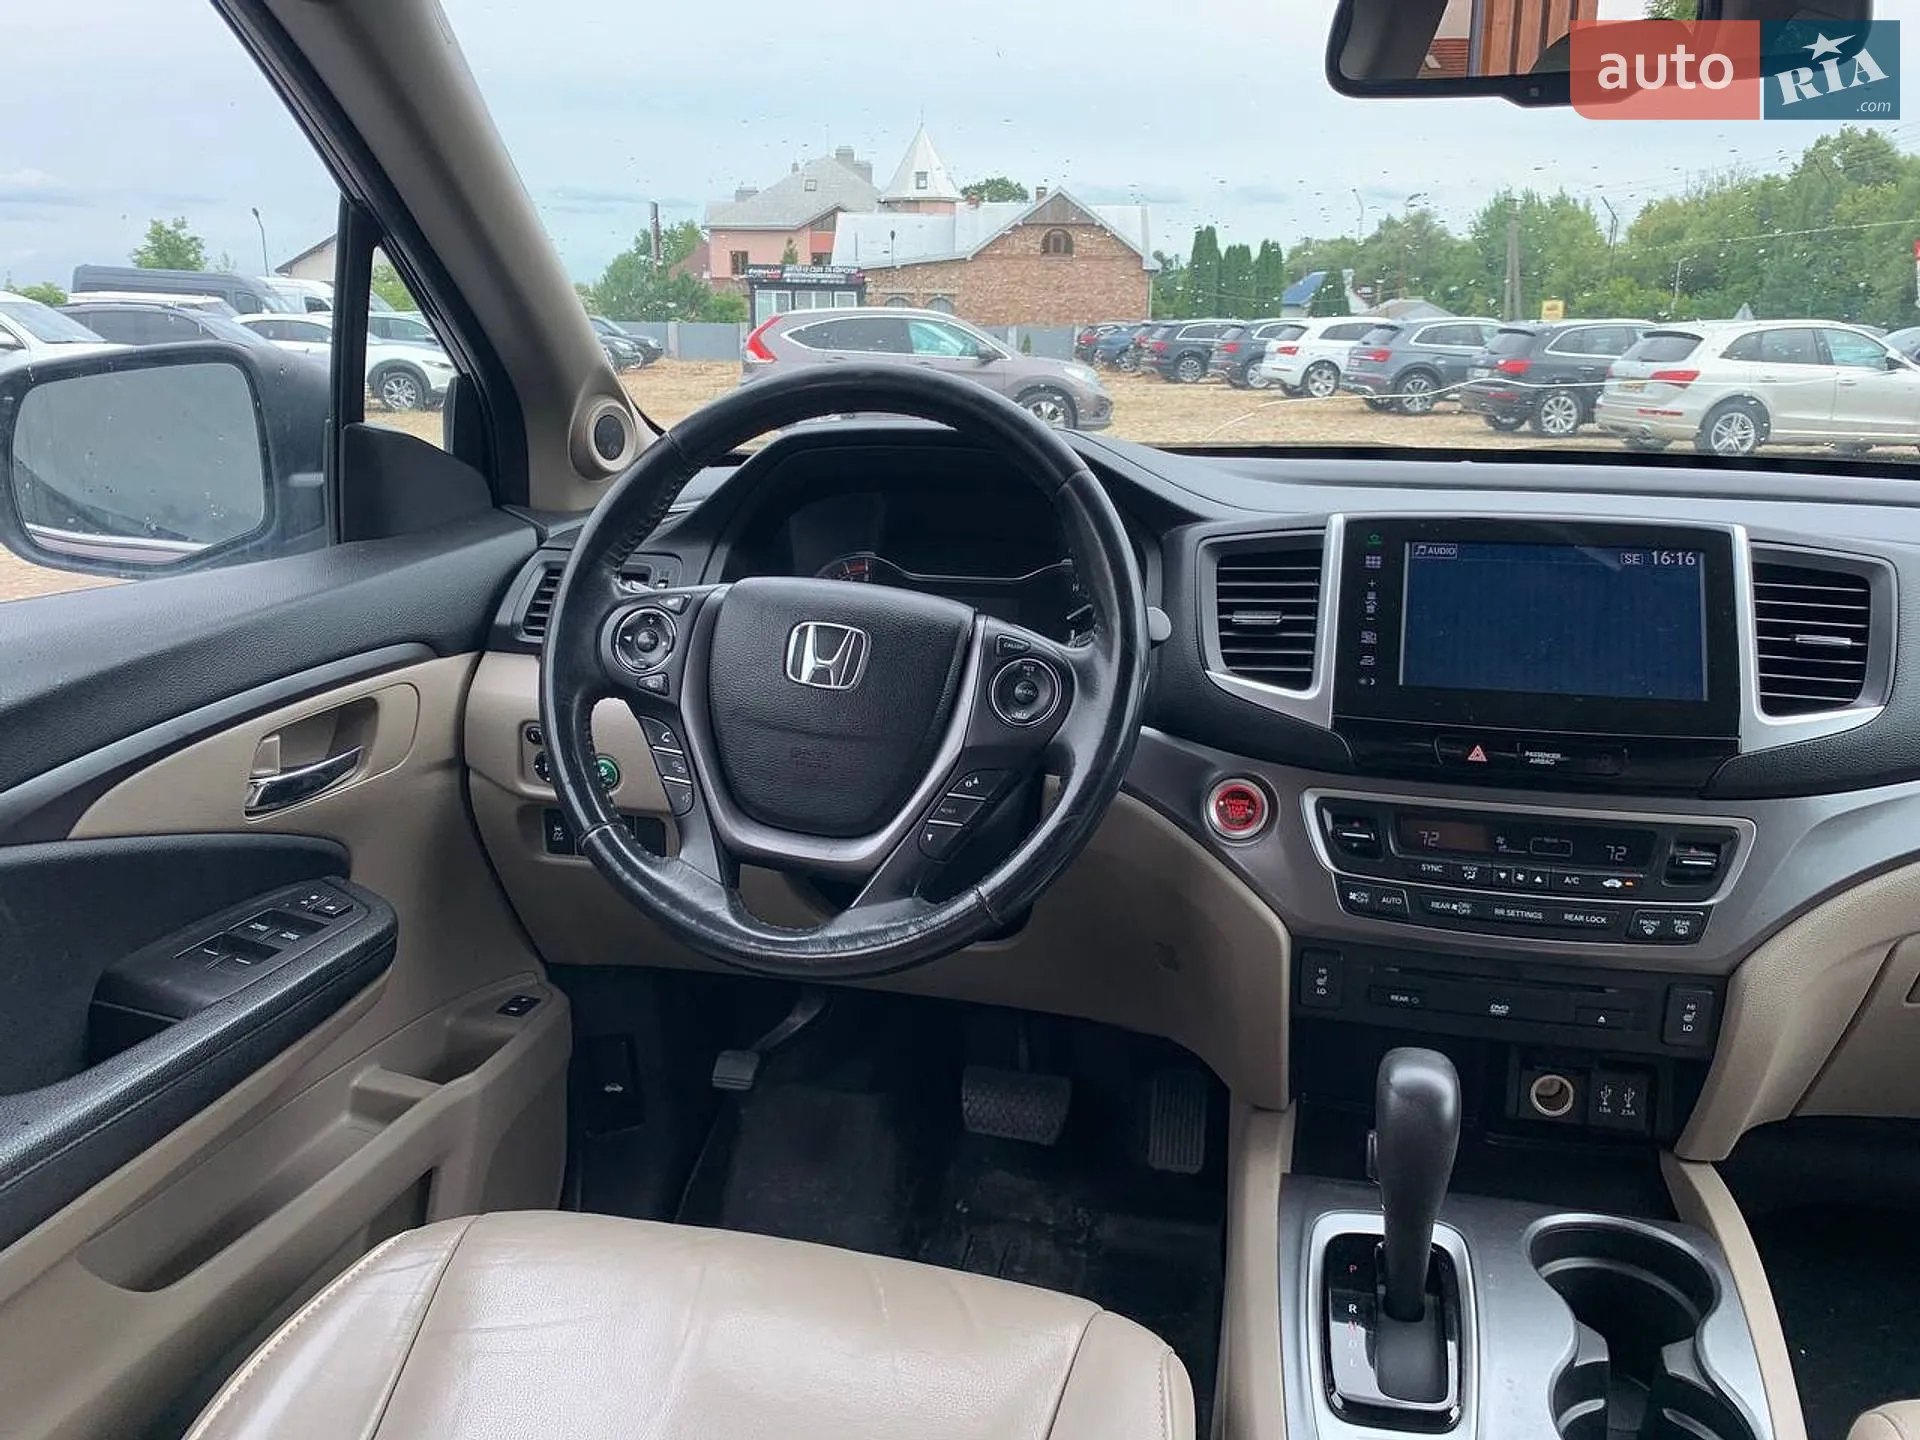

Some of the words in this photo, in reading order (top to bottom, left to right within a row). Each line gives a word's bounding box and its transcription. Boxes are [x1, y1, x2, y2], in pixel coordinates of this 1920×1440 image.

[1427, 547, 1456, 555] AUDIO
[1624, 553, 1641, 564] SE
[1651, 550, 1695, 566] 16:16
[1418, 831, 1440, 847] 72
[1606, 845, 1627, 861] 72
[1421, 864, 1443, 872] SYNC
[1564, 876, 1580, 885] A/C
[1381, 896, 1403, 905] AUTO
[1506, 909, 1543, 919] SETTINGS
[1563, 913, 1583, 922] REAR
[1585, 915, 1607, 924] LOCK
[1349, 1264, 1357, 1273] P
[1348, 1303, 1357, 1314] R
